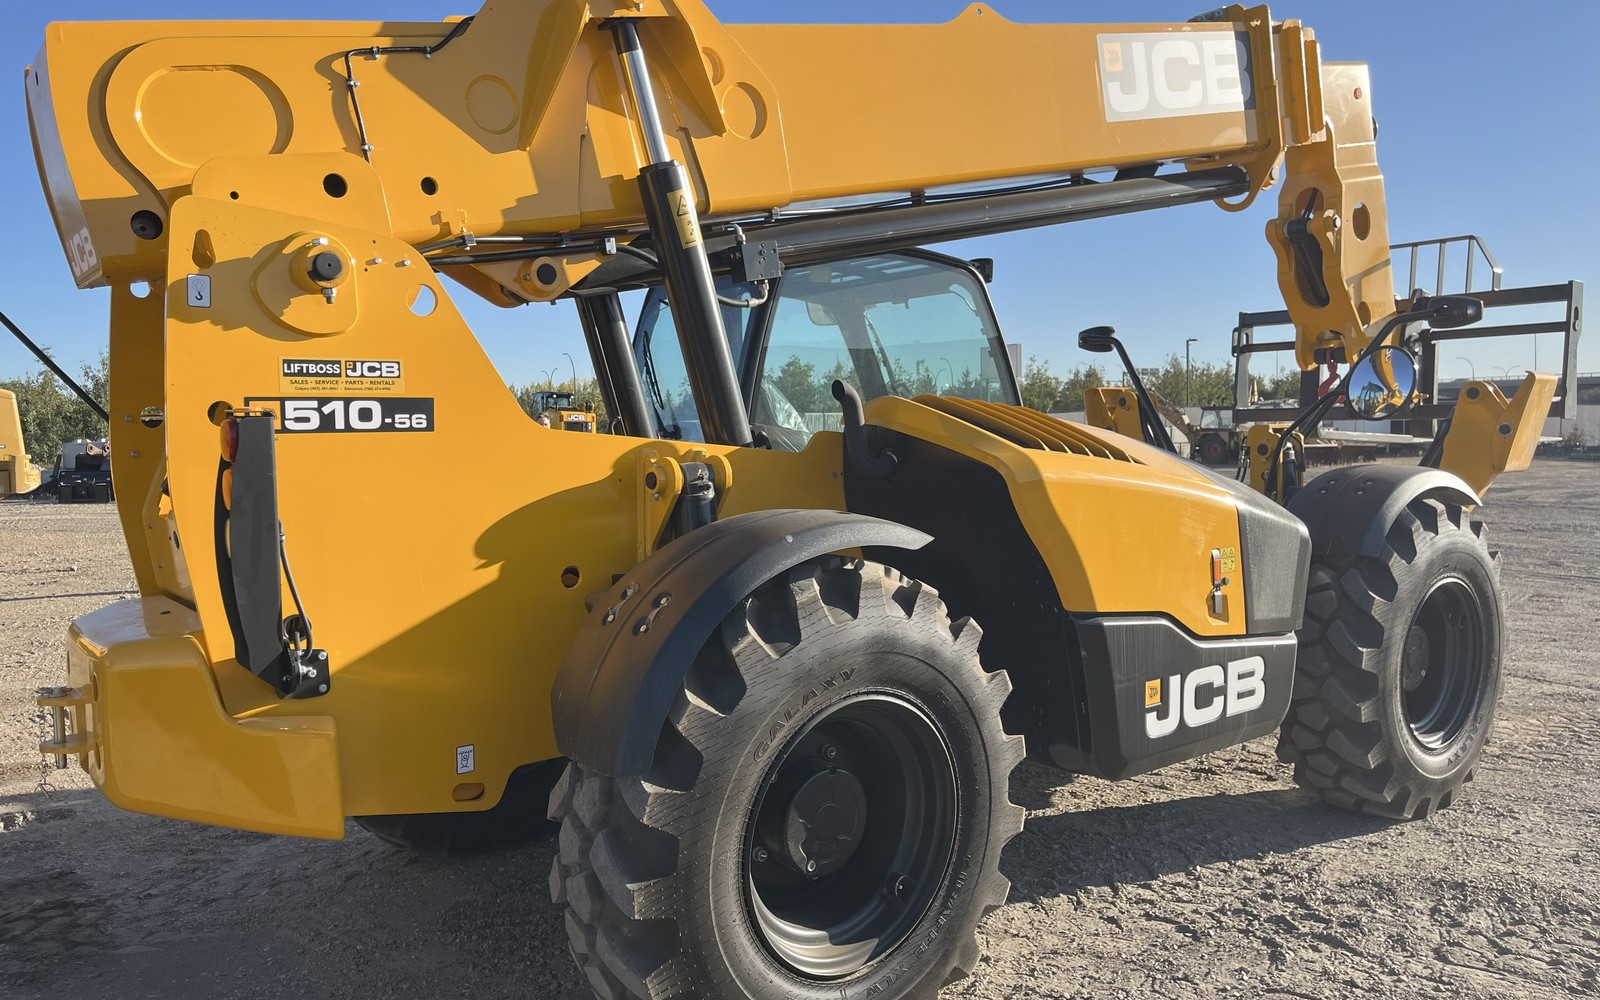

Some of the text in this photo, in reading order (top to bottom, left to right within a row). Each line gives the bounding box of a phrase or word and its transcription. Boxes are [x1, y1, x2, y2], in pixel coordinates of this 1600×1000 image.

[1106, 39, 1251, 113] JCB
[69, 226, 98, 277] JCB
[283, 362, 400, 377] LIFTBOSS JCB
[284, 400, 428, 431] 510-56
[754, 667, 857, 762] GALAXY
[1145, 655, 1266, 739] JCB
[1446, 712, 1484, 766] GALAXY
